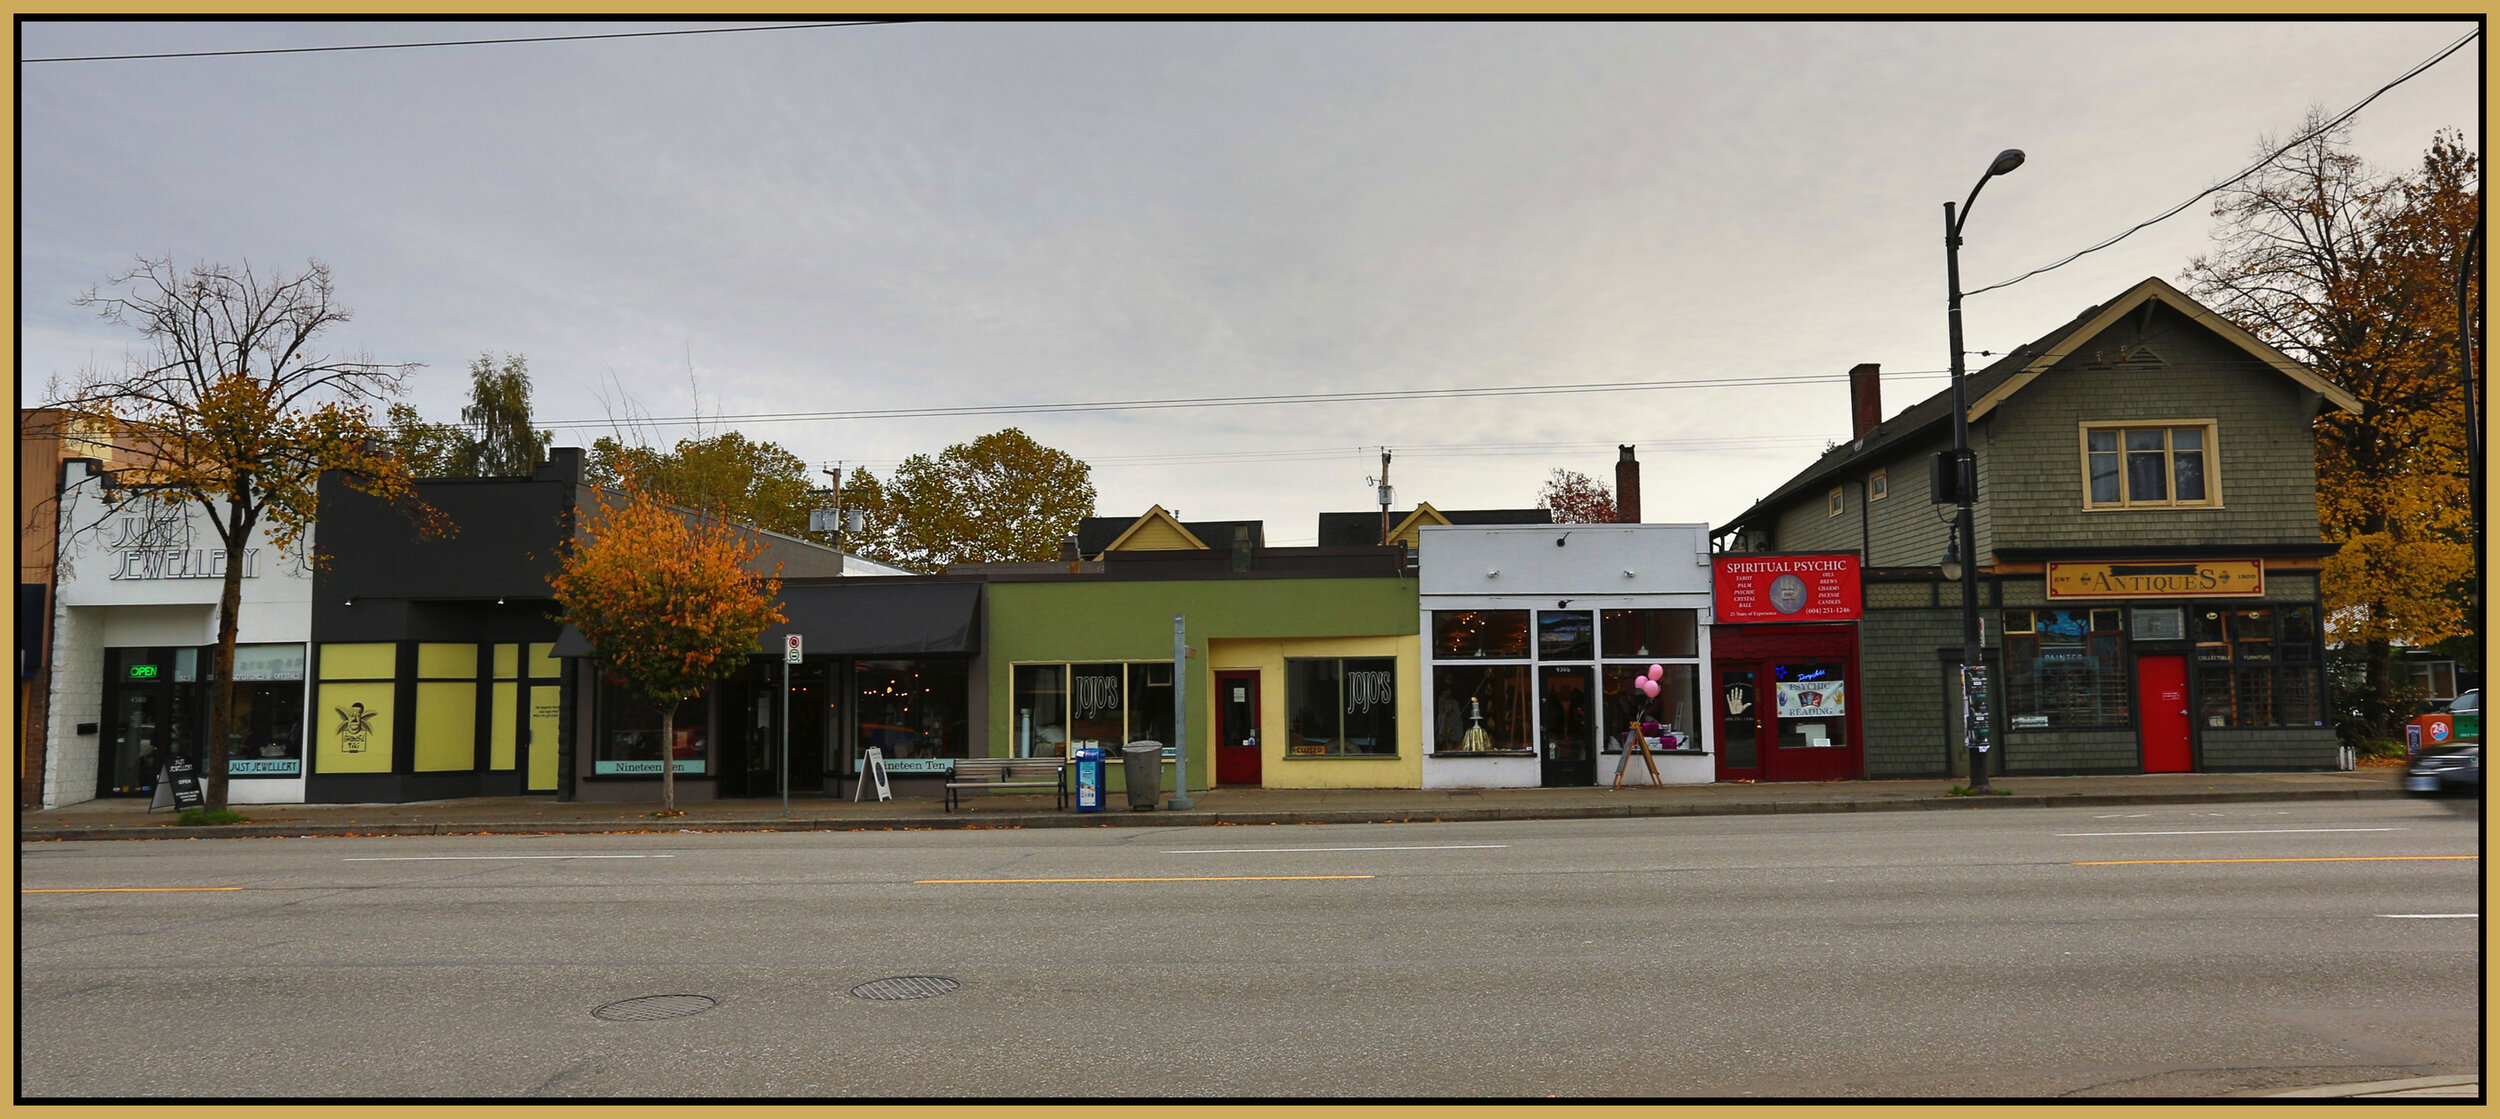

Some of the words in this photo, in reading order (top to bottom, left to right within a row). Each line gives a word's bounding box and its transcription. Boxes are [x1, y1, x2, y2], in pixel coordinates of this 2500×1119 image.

[111, 517, 180, 548] JUST
[109, 548, 260, 581] JEWELLEY
[1727, 562, 1791, 574] SPIRITUAL
[1794, 560, 1847, 571] PSYCHIC
[2092, 569, 2217, 592] ANTIQUES
[129, 666, 158, 677] OPEN
[1789, 682, 1830, 691] PSYCHIC
[1074, 676, 1118, 719] JOJO'S
[1347, 671, 1392, 714] JOJO'S
[1789, 707, 1833, 716] READING
[2432, 723, 2446, 734] 24
[230, 762, 249, 772] JUST
[252, 762, 297, 771] JEWELLERY
[616, 763, 662, 772] Nineteen
[884, 761, 922, 770] ineteen
[925, 761, 946, 770] Ten
